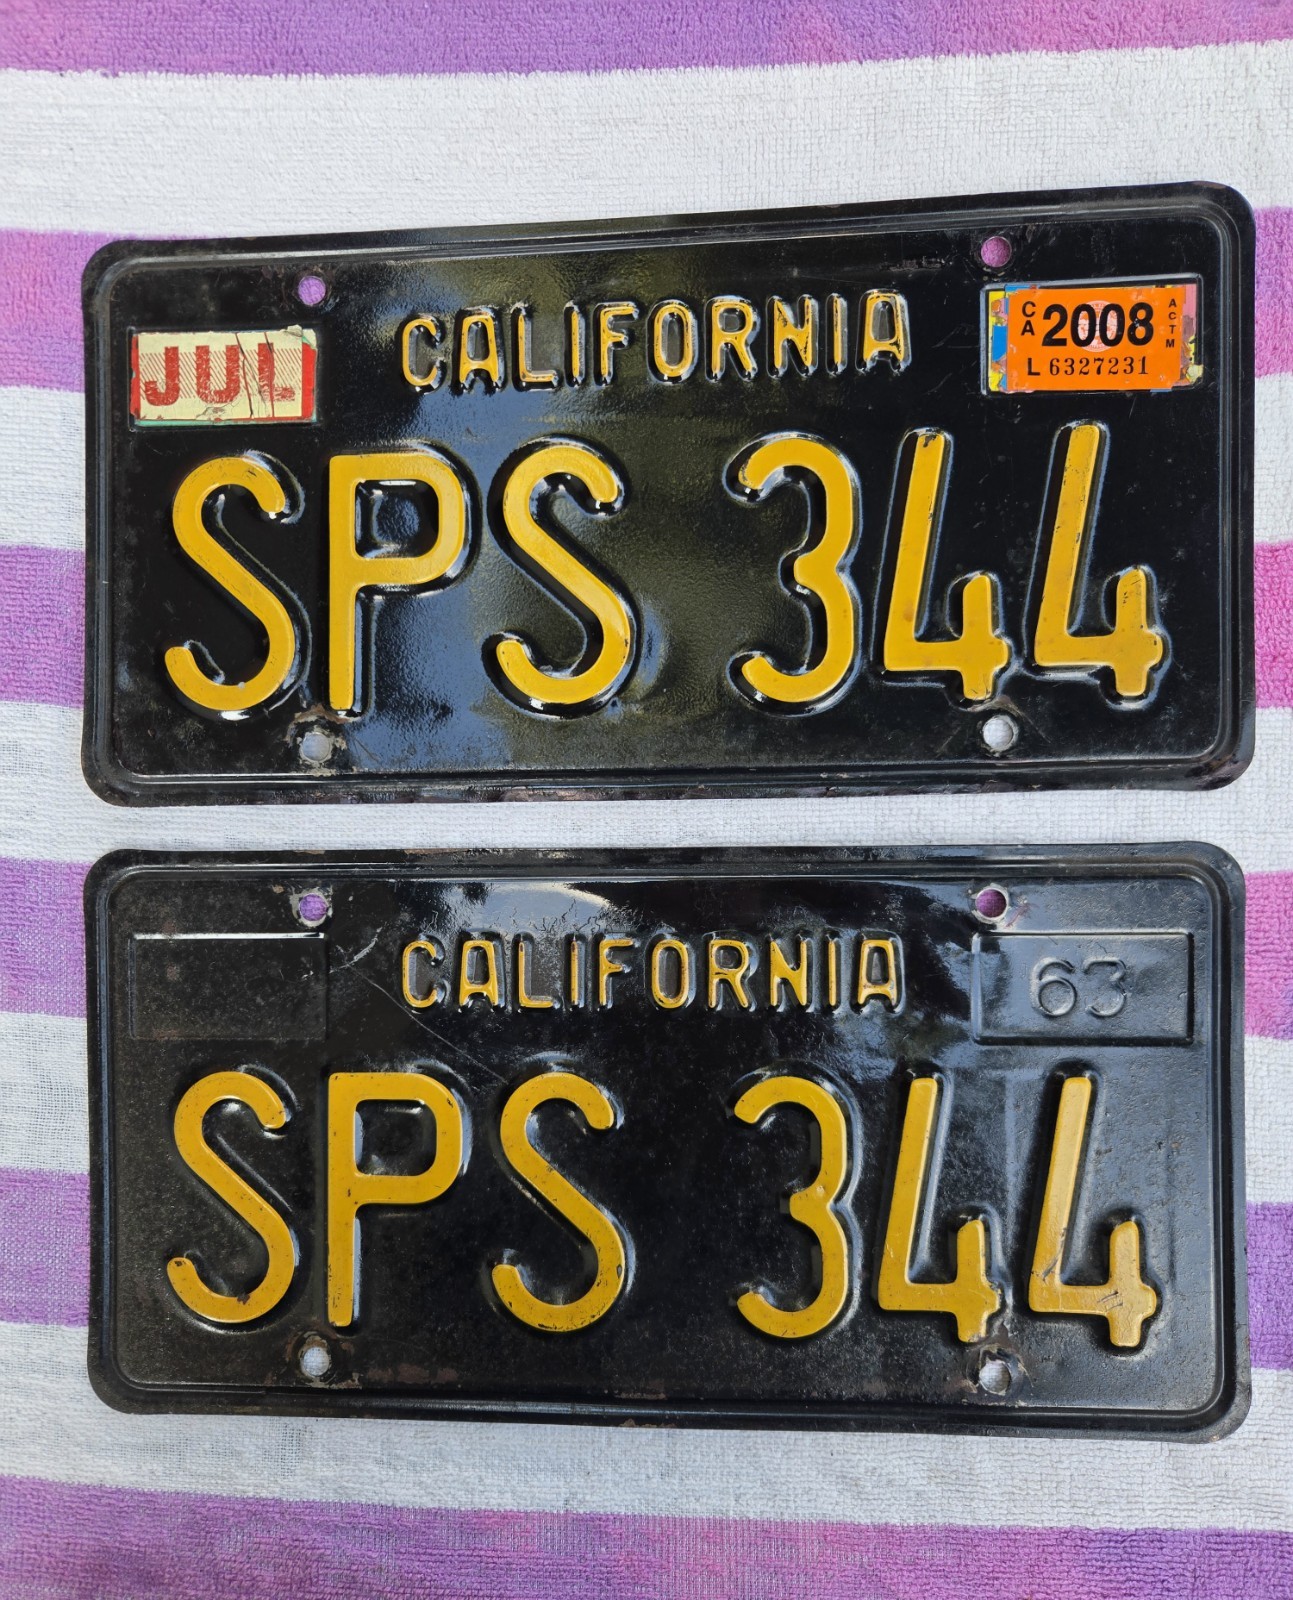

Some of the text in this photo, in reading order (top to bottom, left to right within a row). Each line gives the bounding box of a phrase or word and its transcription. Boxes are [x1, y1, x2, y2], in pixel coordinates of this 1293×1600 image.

[400, 291, 907, 391] CALIFORNIA
[1021, 300, 1036, 336] CA
[1041, 302, 1154, 347] 2008
[143, 342, 296, 406] JUL
[1027, 356, 1149, 376] L 6327231
[164, 422, 1166, 712] SPS 344
[400, 935, 902, 1011] CALIFORNIA
[1031, 957, 1127, 1017] 63
[165, 1070, 1158, 1348] SPS 344
